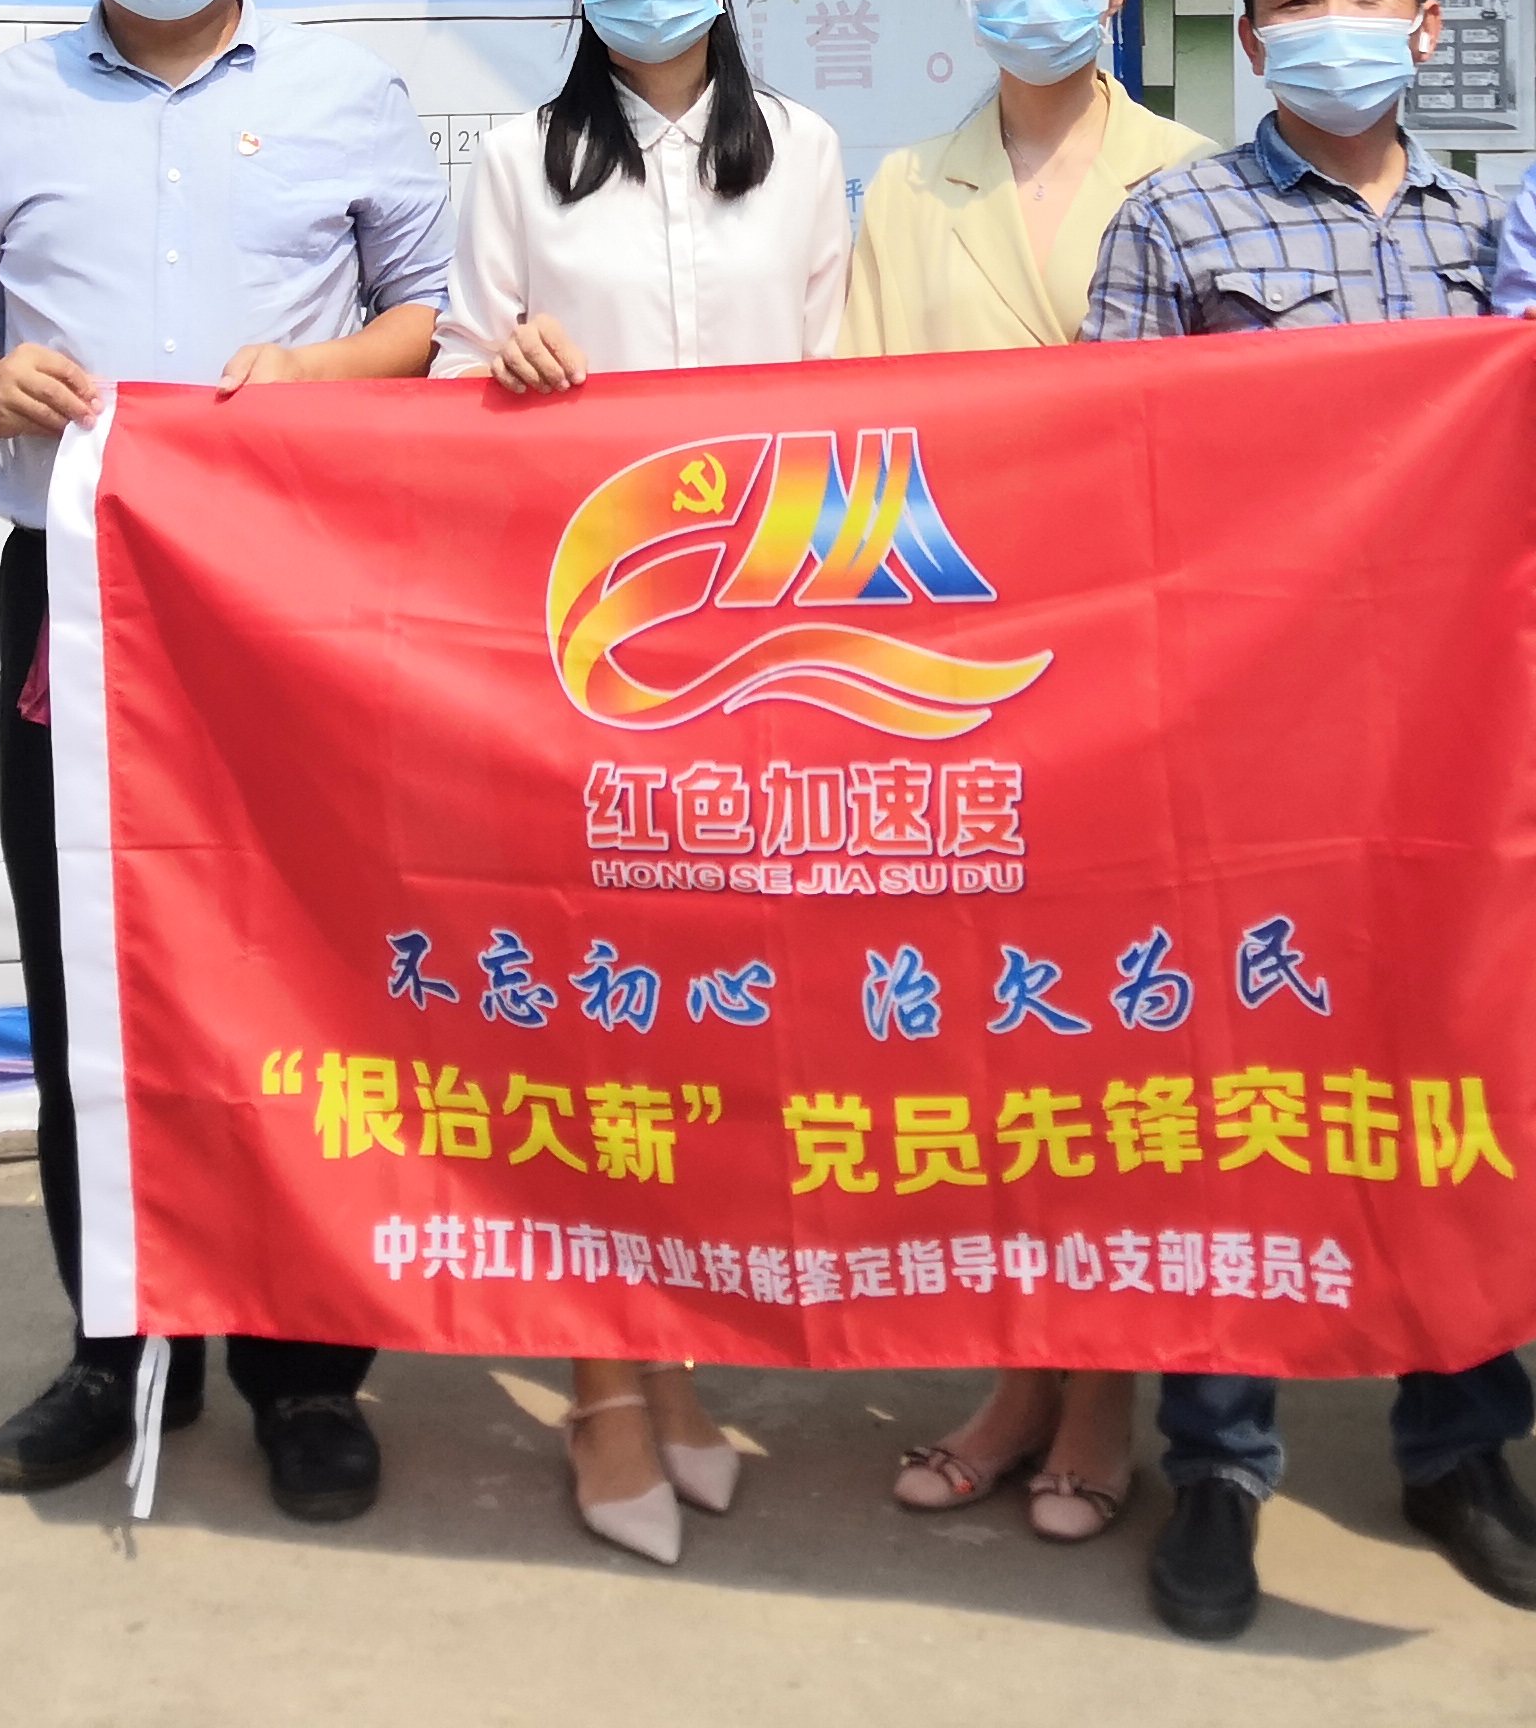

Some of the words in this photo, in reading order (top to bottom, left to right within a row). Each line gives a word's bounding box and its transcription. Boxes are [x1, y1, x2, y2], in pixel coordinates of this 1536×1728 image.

[429, 131, 442, 152] 9
[584, 759, 1026, 859] 红色加速度
[591, 858, 723, 893] HONG
[725, 861, 795, 895] SE
[795, 862, 879, 896] JIA
[880, 862, 949, 896] SU
[952, 861, 1025, 896] DU
[385, 928, 777, 1034] 不忘初心
[861, 914, 1333, 1041] 治欠为民
[782, 1065, 1518, 1195] 党员先锋突击队
[372, 1214, 1353, 1309] 中共江门市职业技能鉴定指导中心支部委员会
